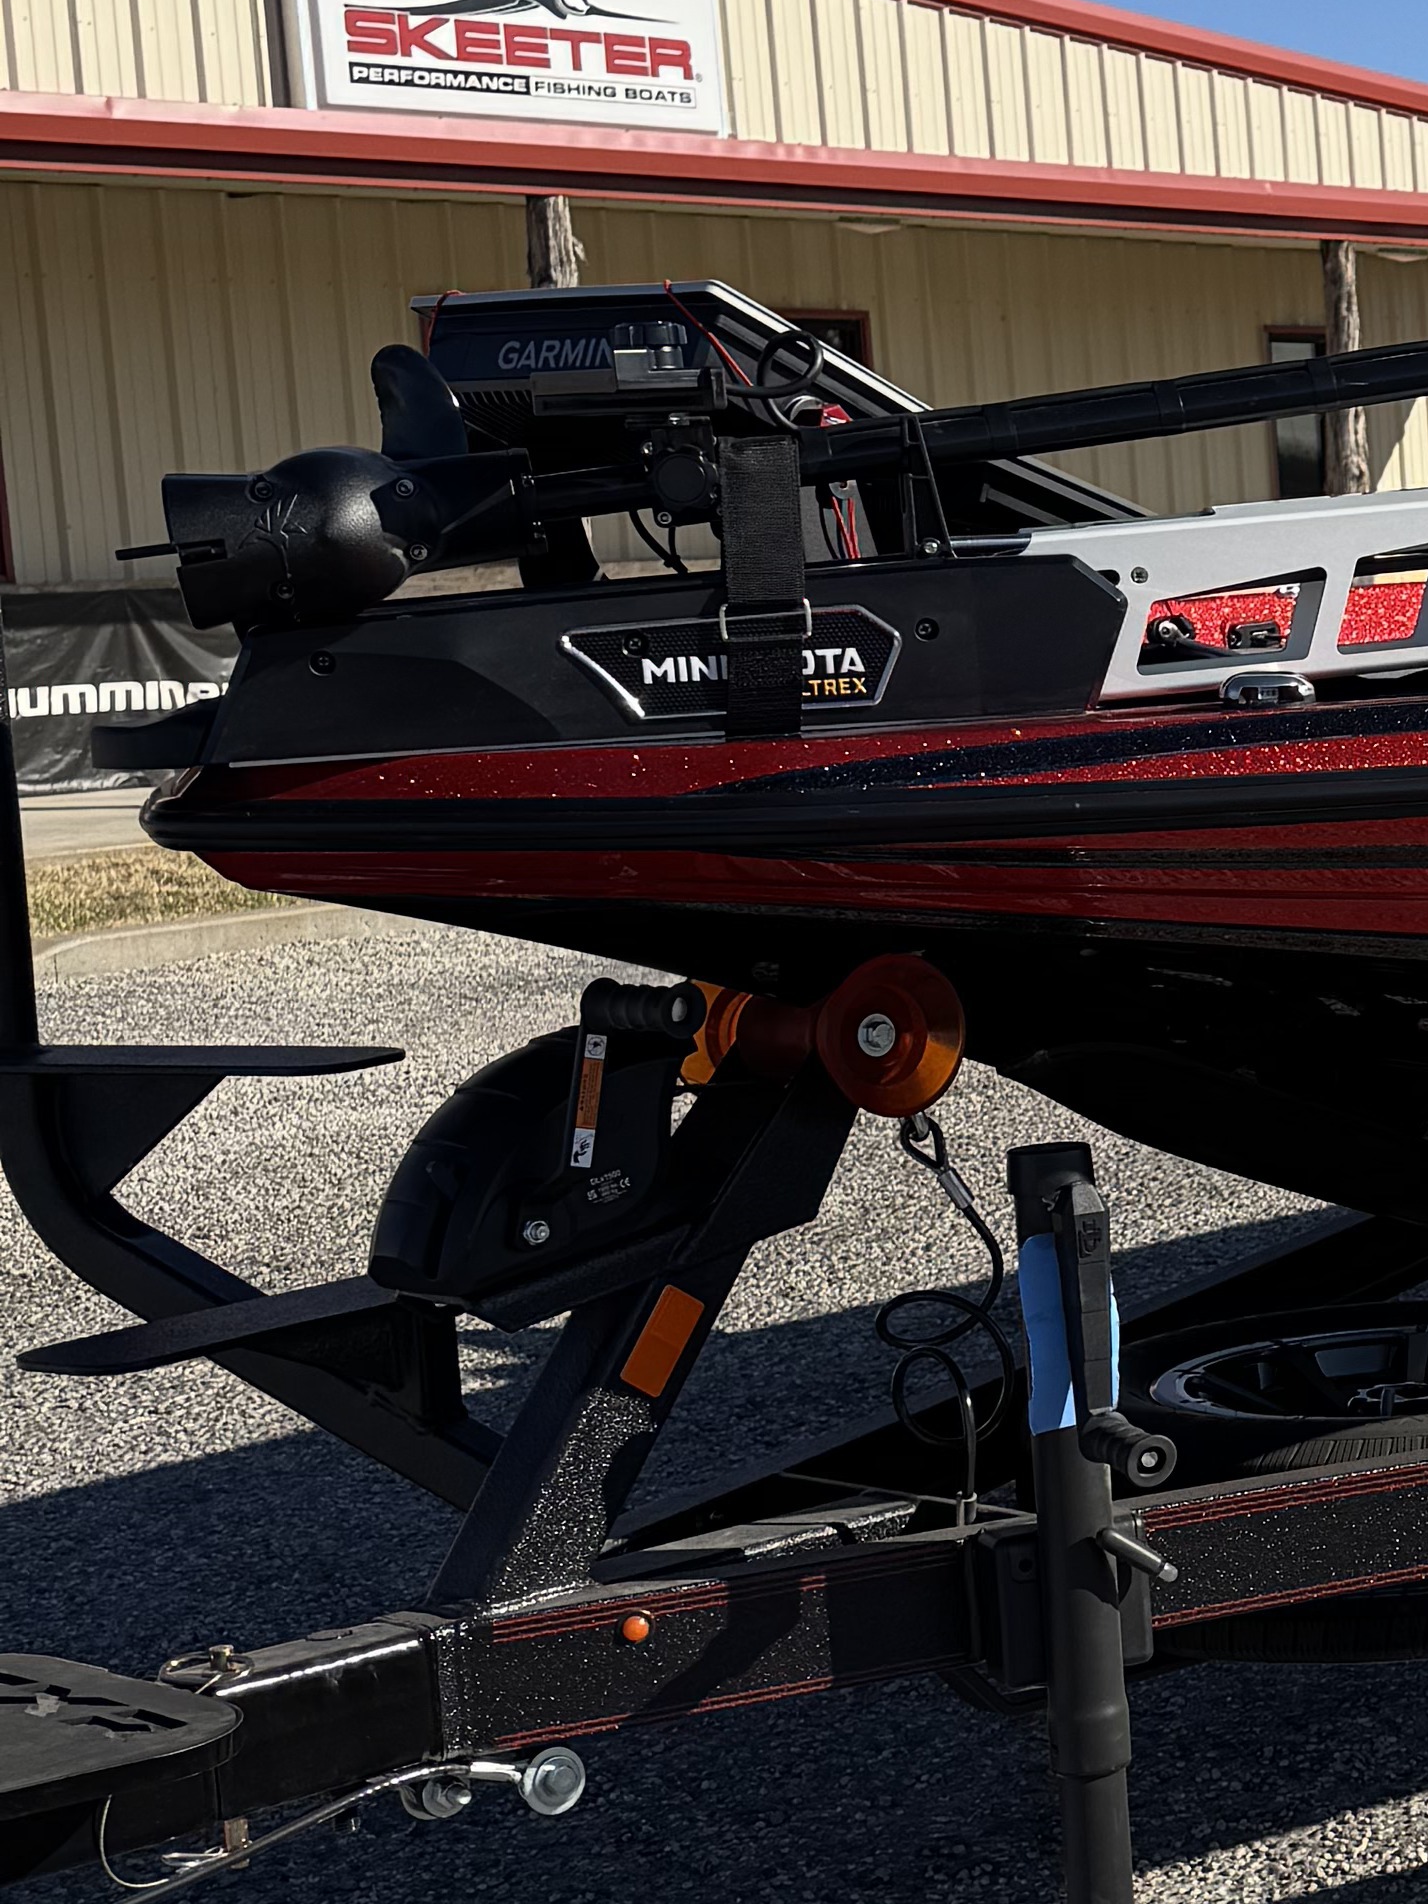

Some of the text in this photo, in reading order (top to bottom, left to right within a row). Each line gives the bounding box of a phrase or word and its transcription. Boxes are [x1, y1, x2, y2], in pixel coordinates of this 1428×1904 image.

[344, 8, 694, 80] SKEETER
[352, 65, 693, 103] PERFORMANCE FISHING BOATS
[498, 338, 615, 370] GARMIN
[802, 647, 866, 675] OTA
[802, 677, 868, 696] TREX
